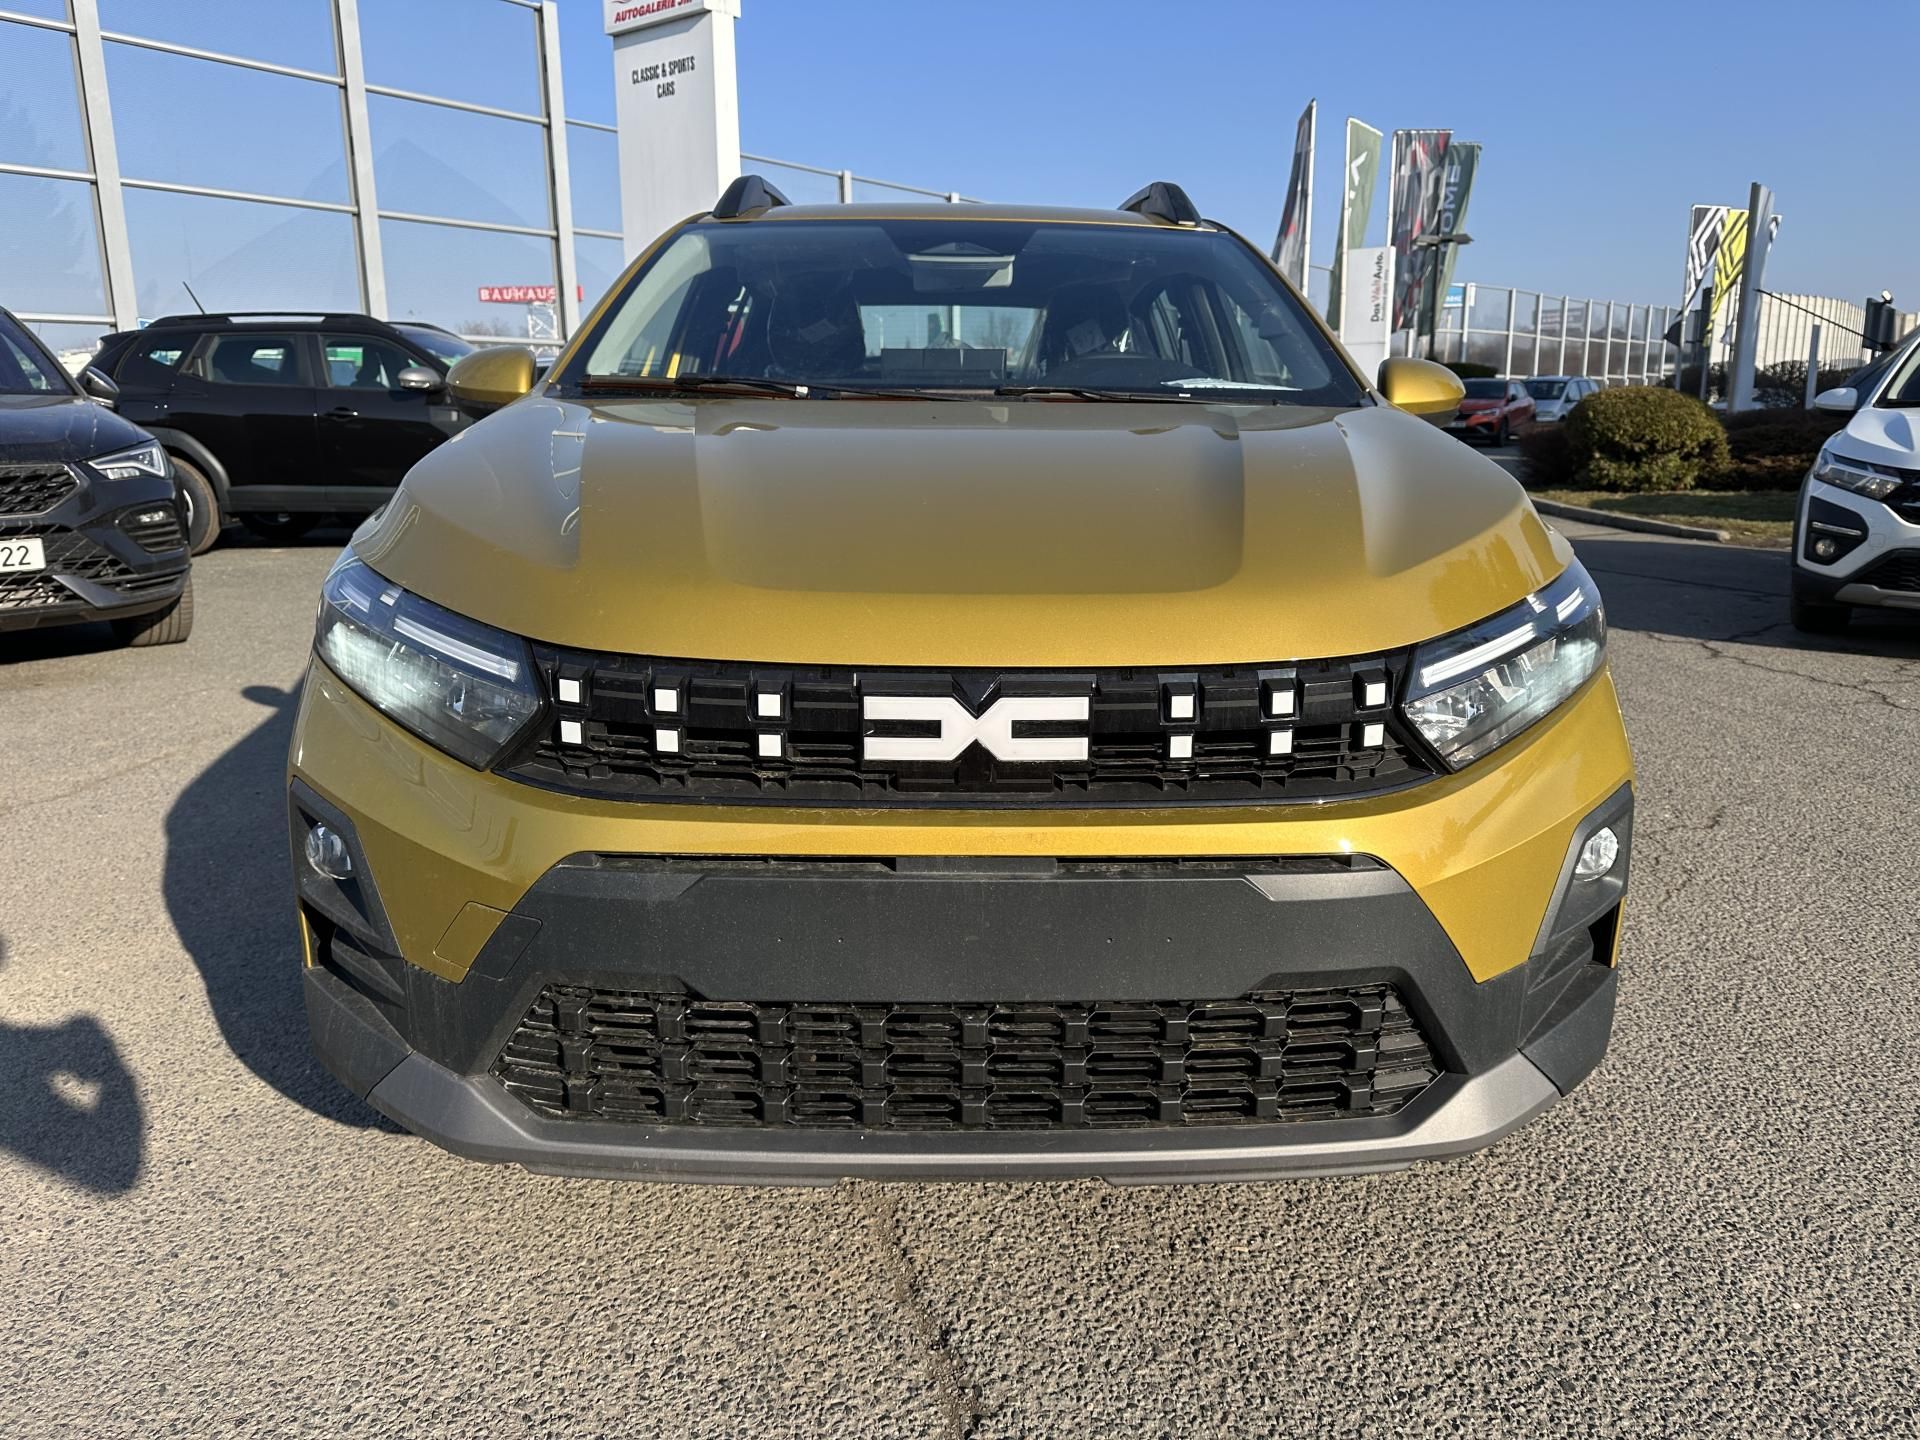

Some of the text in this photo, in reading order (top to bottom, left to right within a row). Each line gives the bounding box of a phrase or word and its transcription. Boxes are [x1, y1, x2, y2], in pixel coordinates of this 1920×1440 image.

[614, 0, 676, 23] AUTOGALERIE
[632, 56, 696, 84] CLASSIC & SPORTS
[656, 81, 676, 98] CARS
[0, 545, 31, 567] 22
